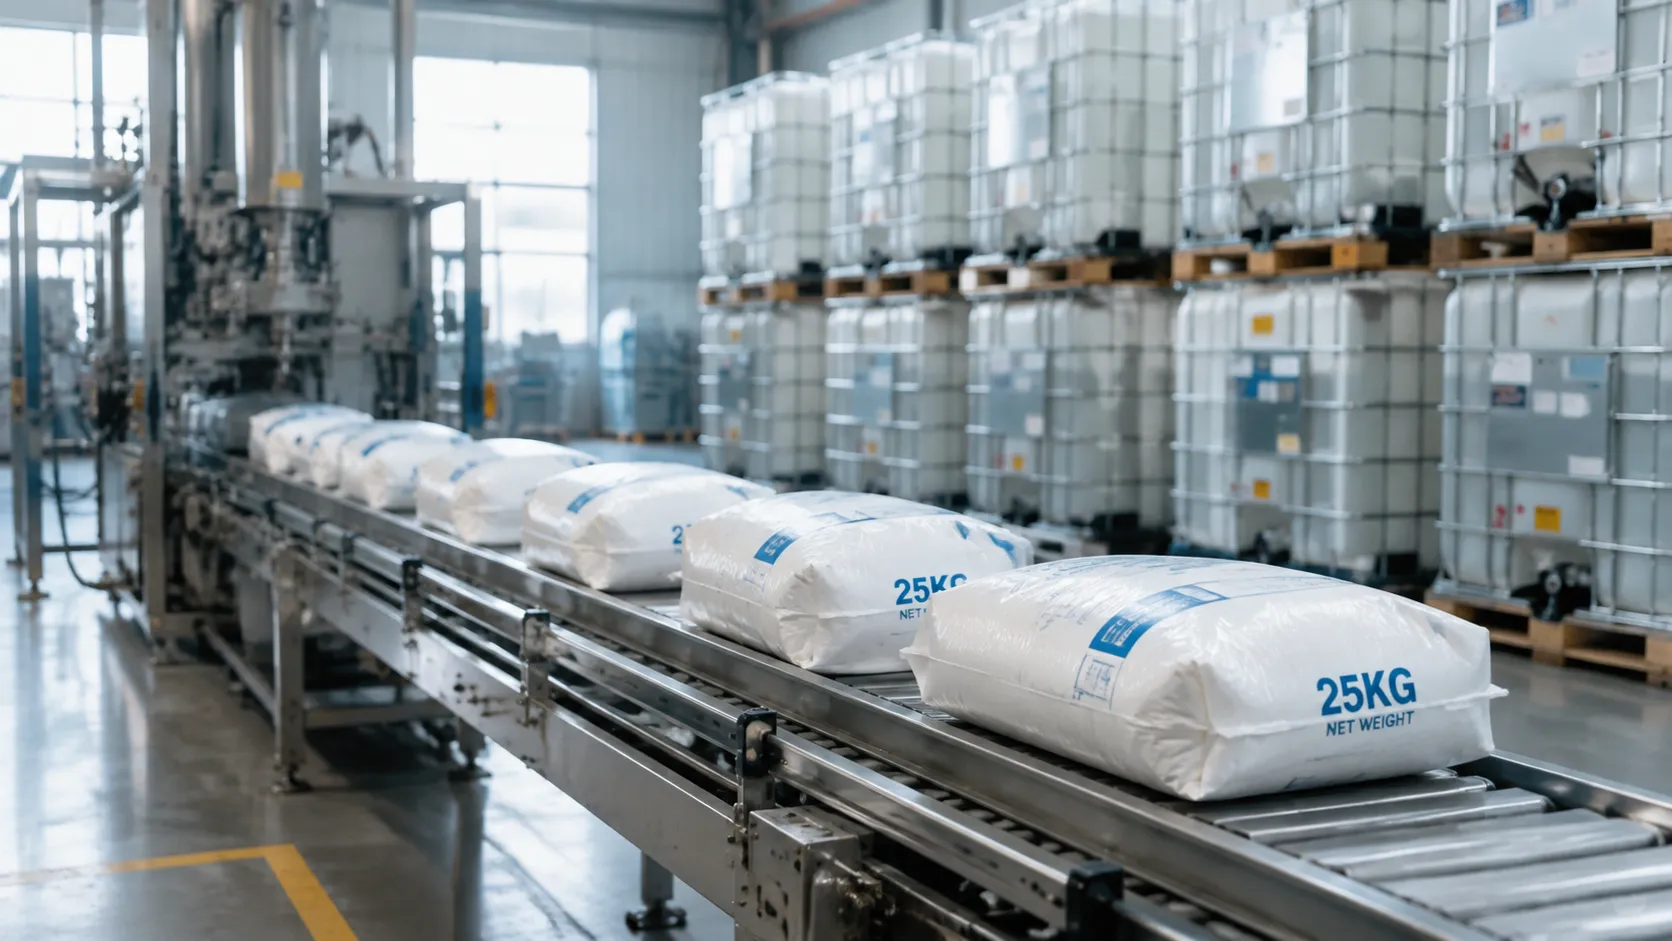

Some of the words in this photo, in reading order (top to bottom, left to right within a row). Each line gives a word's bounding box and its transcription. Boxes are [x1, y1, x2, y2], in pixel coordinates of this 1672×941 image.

[899, 607, 922, 620] NET
[1316, 667, 1417, 716] 25KG
[1326, 719, 1356, 737] NET
[1359, 710, 1415, 732] WEIGHT
